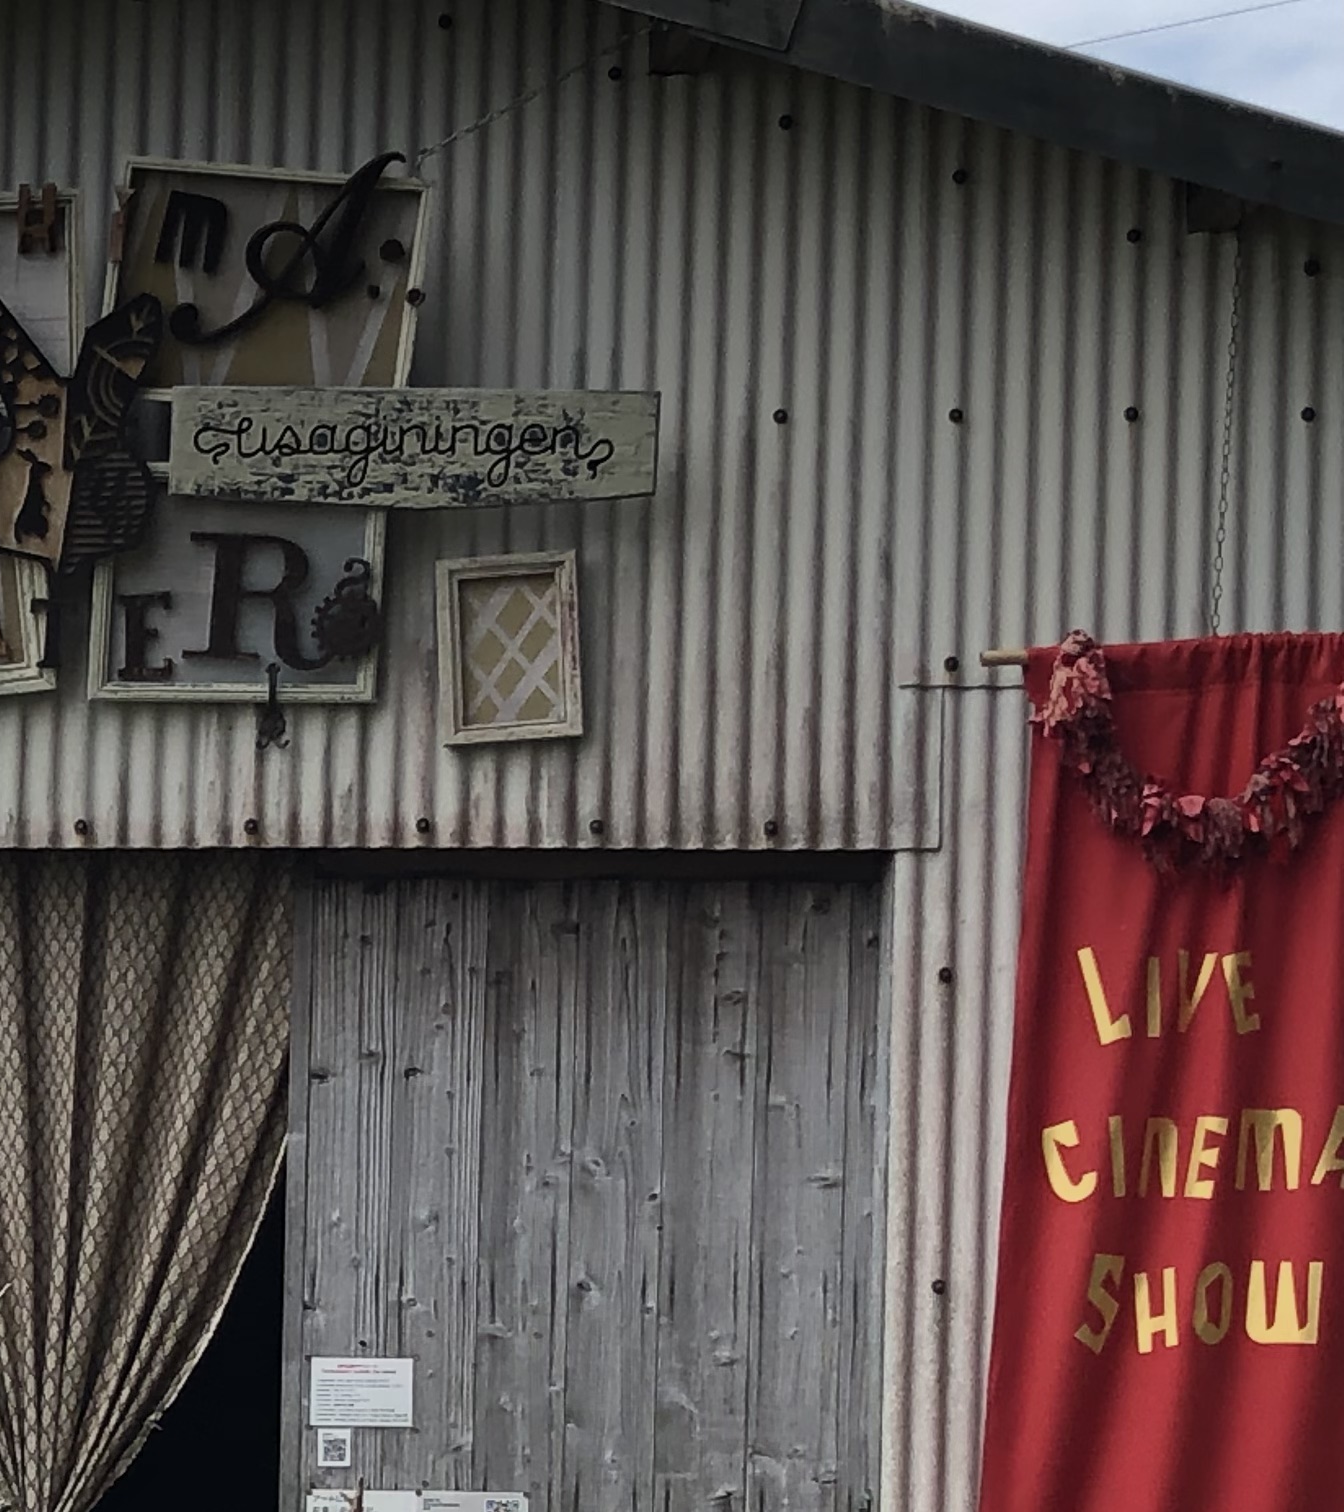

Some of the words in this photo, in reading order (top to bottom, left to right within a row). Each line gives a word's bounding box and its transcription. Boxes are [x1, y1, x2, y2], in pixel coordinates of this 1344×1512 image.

[1077, 945, 1262, 1046] LIVE
[1041, 1105, 1344, 1204] CINEMA
[1073, 1252, 1325, 1355] SHOW
